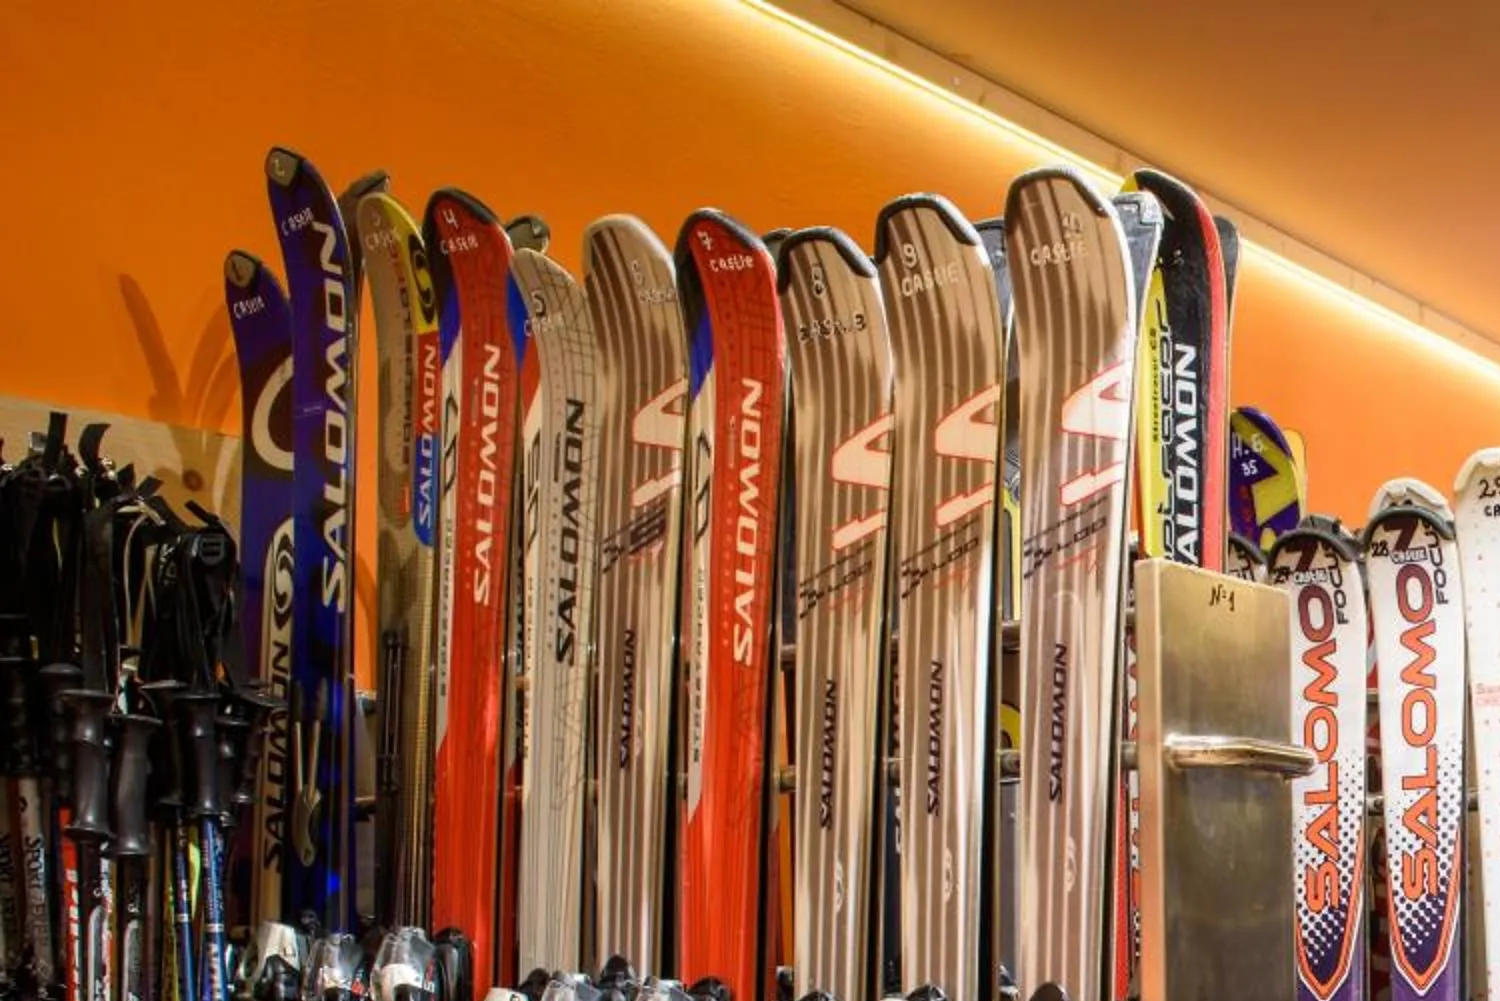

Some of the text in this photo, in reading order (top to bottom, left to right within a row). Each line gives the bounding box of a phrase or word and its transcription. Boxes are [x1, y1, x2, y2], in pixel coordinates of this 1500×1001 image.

[443, 209, 458, 228] 4
[901, 242, 918, 266] 9
[321, 220, 347, 612] SALOMON
[418, 344, 438, 528] SALOMON
[473, 344, 501, 606] SALOMON
[1172, 343, 1197, 563] ALOMON
[556, 397, 585, 666] SALOMON
[733, 377, 764, 667] SALOMON
[620, 629, 635, 769] SALOMON
[820, 679, 837, 830] SALOMON
[927, 660, 942, 816] SALOMON
[1049, 644, 1067, 805] SALOMON
